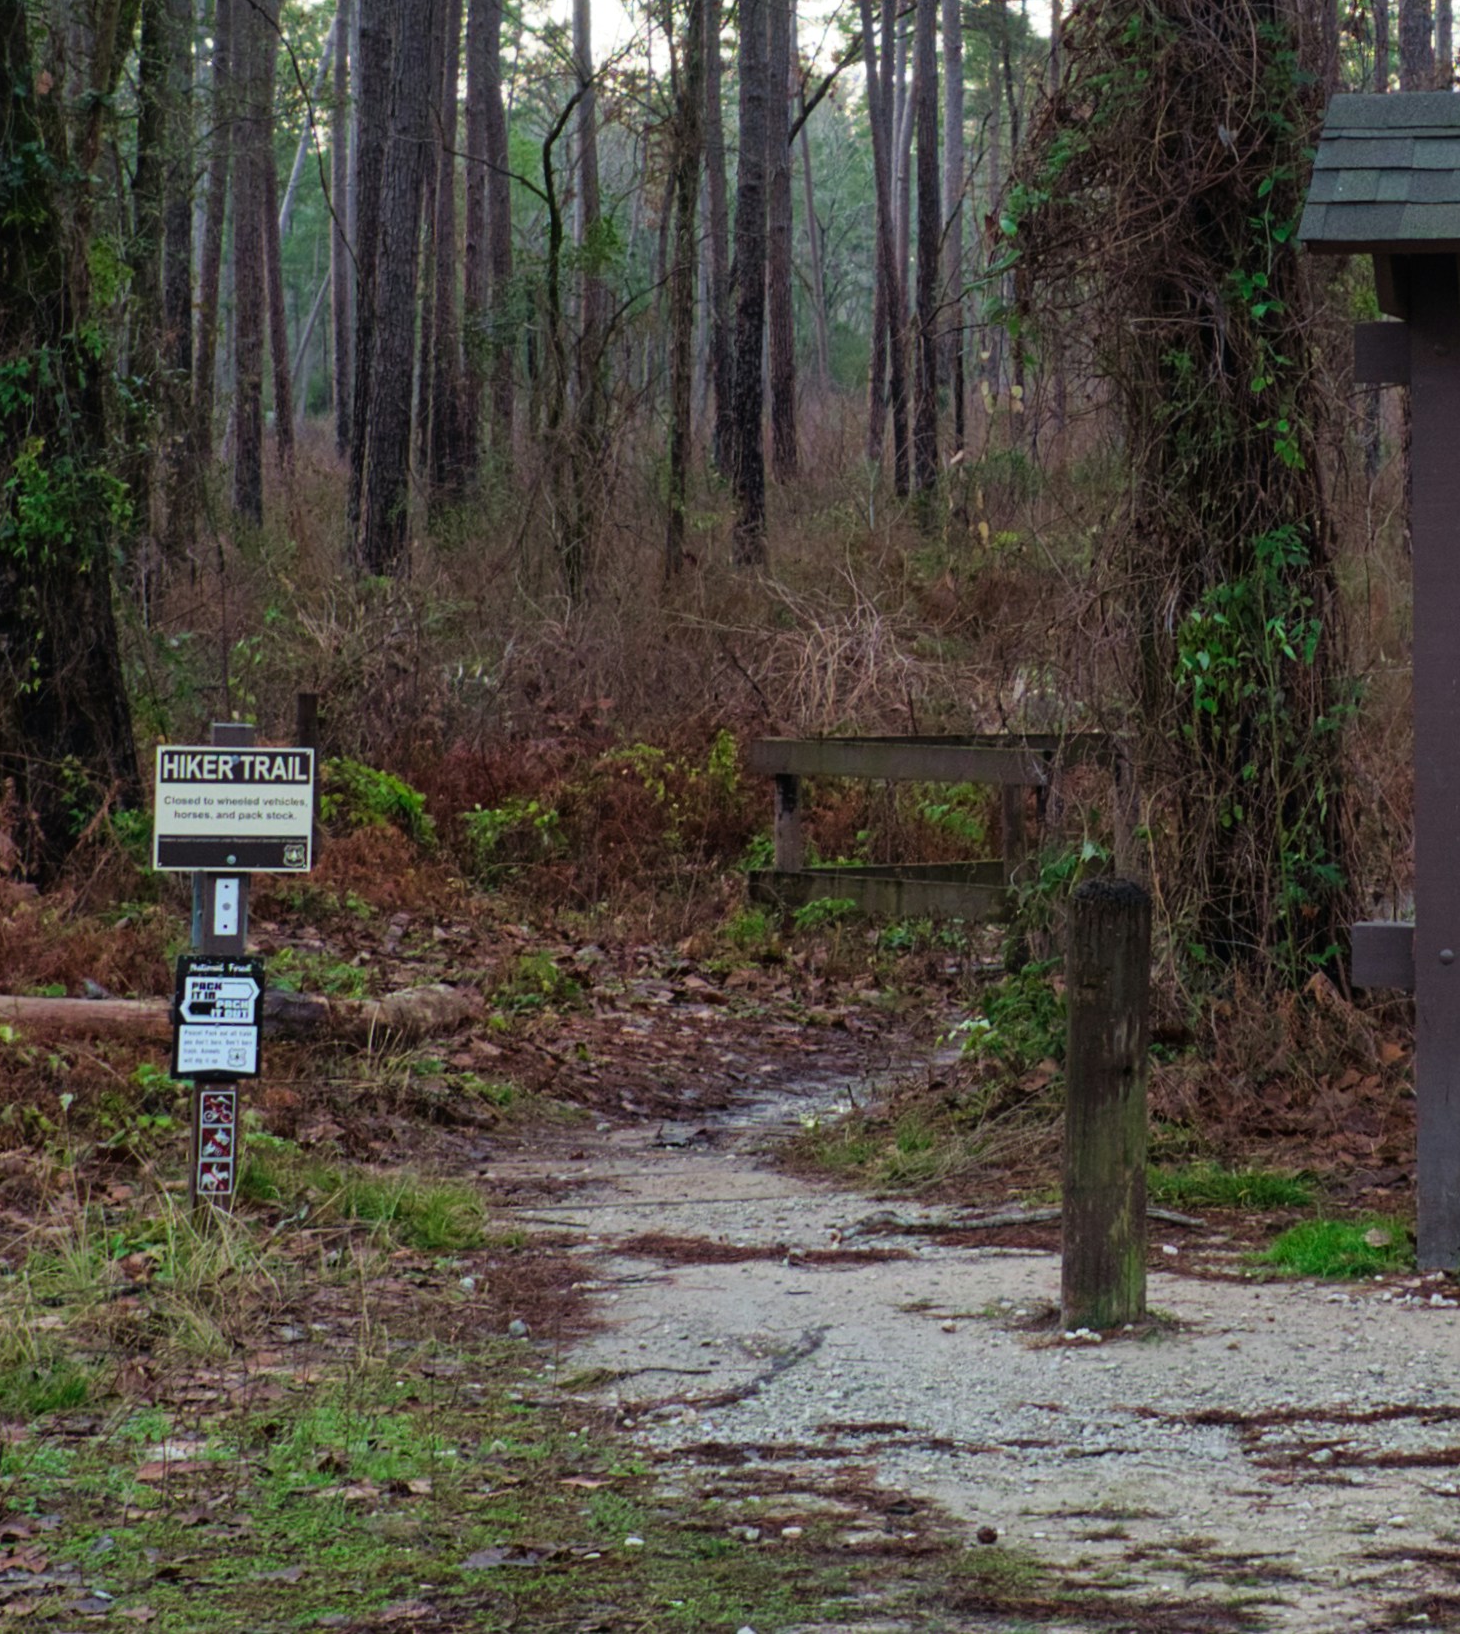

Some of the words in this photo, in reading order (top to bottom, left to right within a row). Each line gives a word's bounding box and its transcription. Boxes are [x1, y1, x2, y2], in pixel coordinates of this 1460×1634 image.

[162, 753, 235, 780] HIKER
[239, 755, 309, 781] TRAIL
[164, 795, 201, 806] Closed
[203, 796, 215, 806] to
[216, 796, 260, 806] wheeled
[263, 796, 309, 808] vehicles,
[174, 810, 214, 821] horses,
[215, 810, 236, 820] and
[238, 810, 264, 822] pack
[266, 811, 298, 821] stock.
[189, 963, 225, 972] National
[191, 982, 223, 991] PACK
[191, 991, 203, 1000] IT
[216, 1000, 250, 1009] PACK
[225, 1009, 250, 1018] OUT
